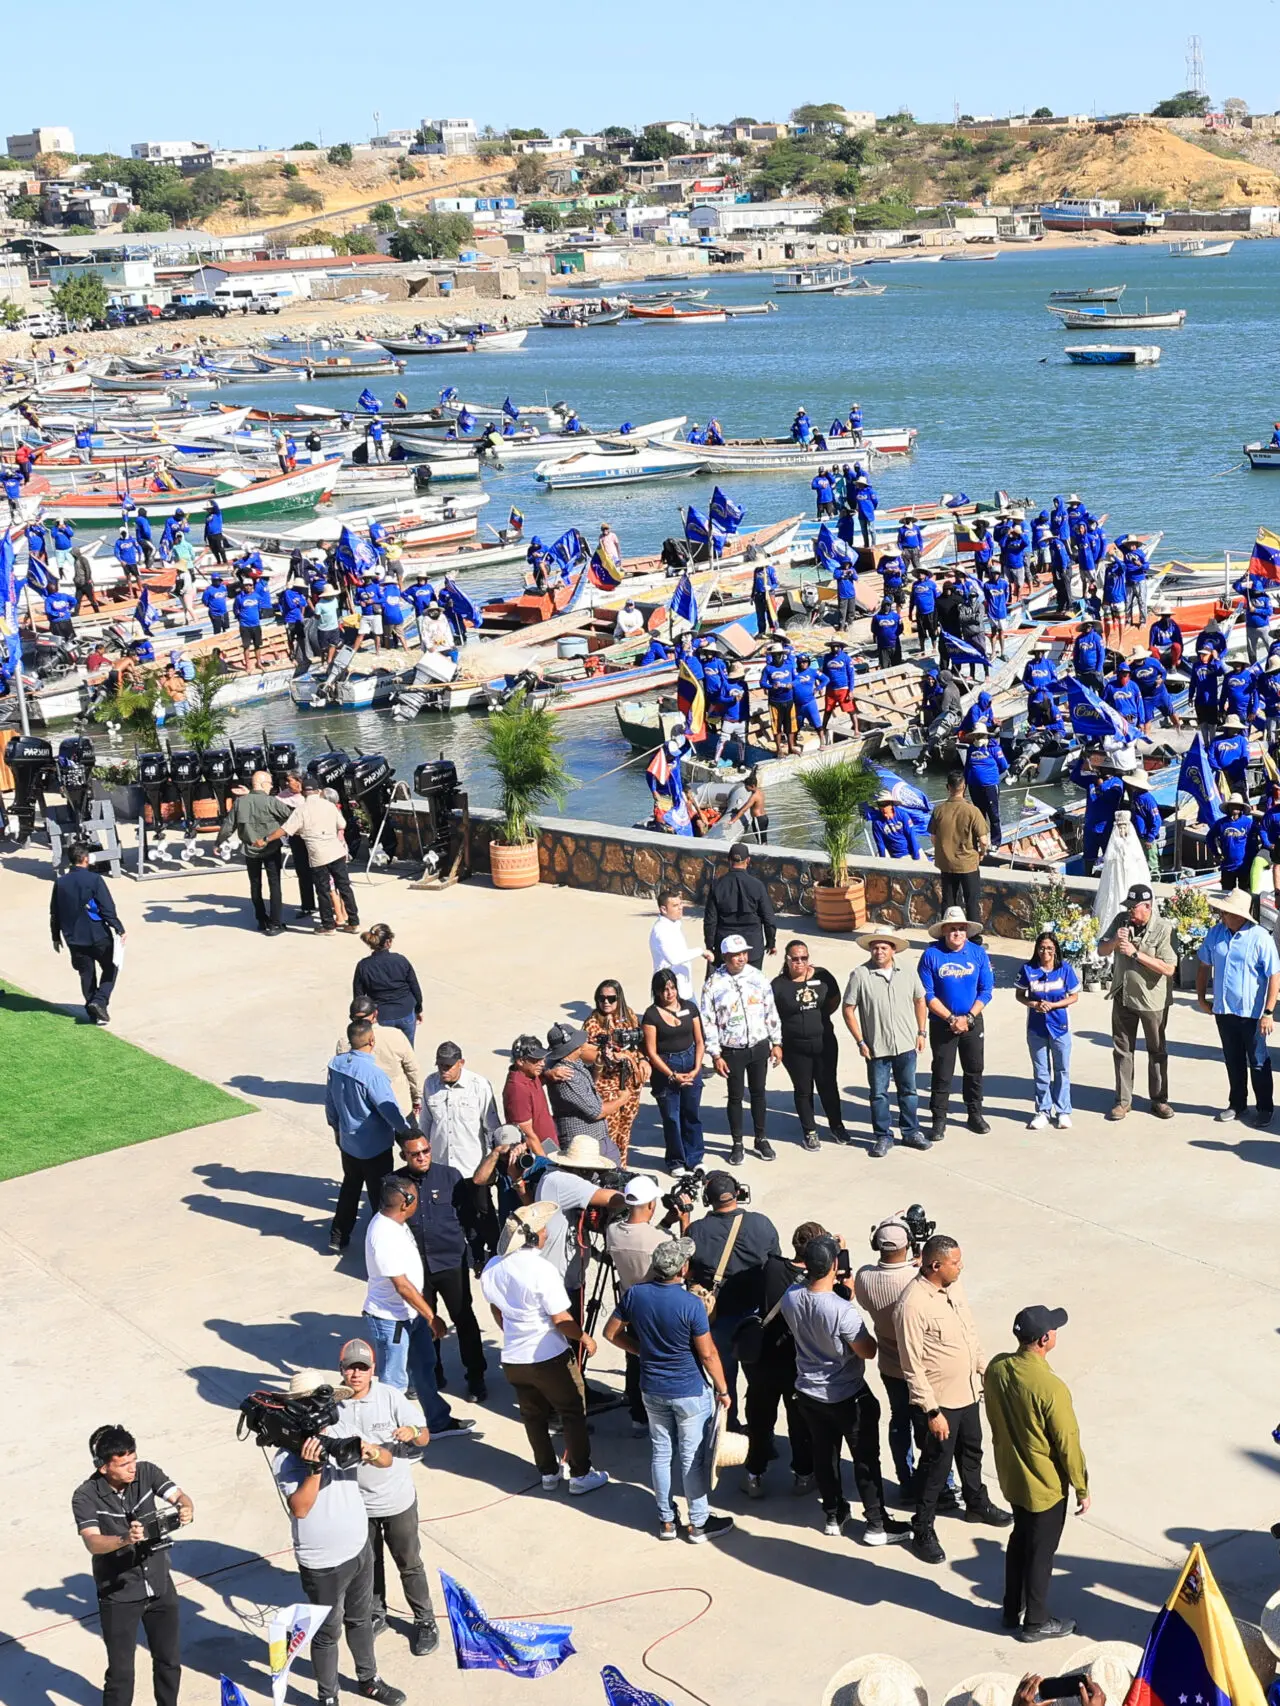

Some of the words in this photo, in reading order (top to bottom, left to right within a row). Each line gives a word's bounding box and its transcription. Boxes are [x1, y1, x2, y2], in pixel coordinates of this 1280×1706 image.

[23, 747, 50, 757] PARSUN
[144, 765, 156, 774] 40
[177, 765, 189, 774] 40
[212, 763, 223, 772] 40
[362, 764, 387, 787] PARSUN
